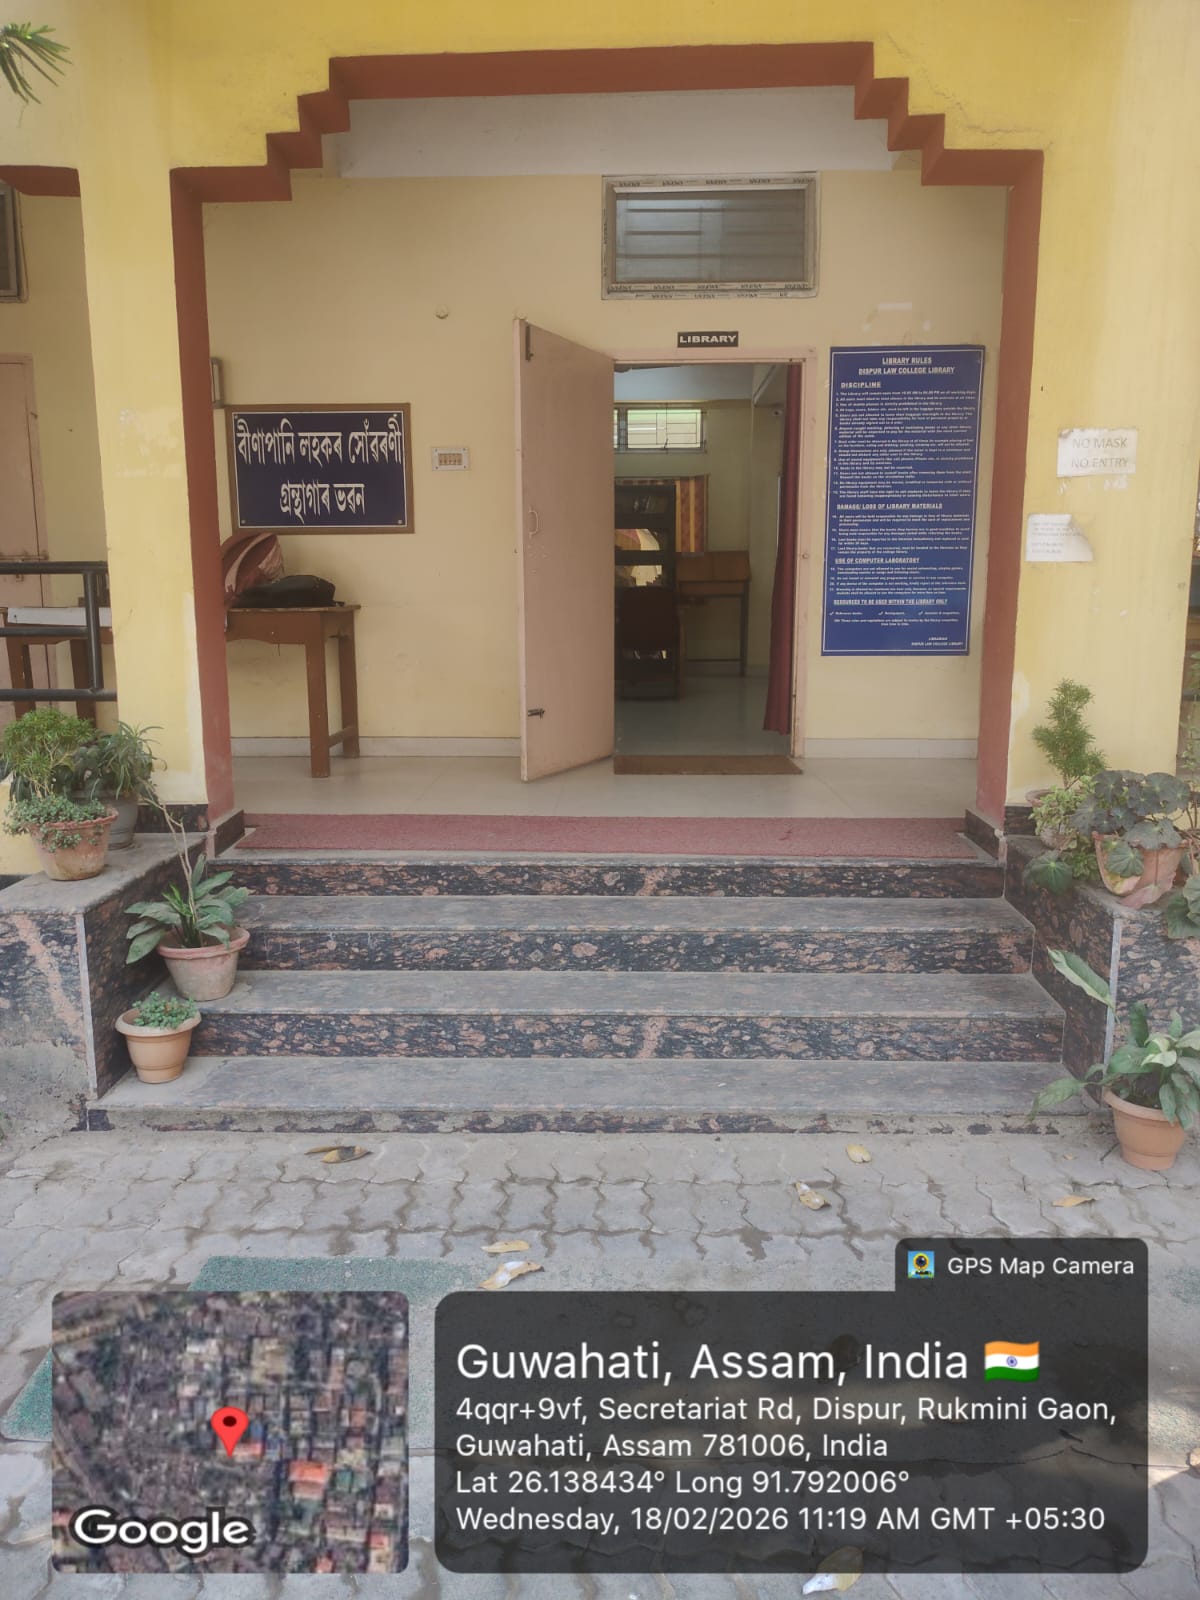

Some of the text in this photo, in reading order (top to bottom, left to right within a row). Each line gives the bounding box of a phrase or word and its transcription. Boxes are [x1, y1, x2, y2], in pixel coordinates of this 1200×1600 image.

[679, 335, 736, 344] LIBRARY
[928, 366, 955, 374] LIBRARY
[1072, 437, 1128, 449] NO MASK
[298, 431, 343, 468] লহকৰ
[1071, 456, 1129, 468] NO ENTRY
[333, 483, 366, 515] ভৱন
